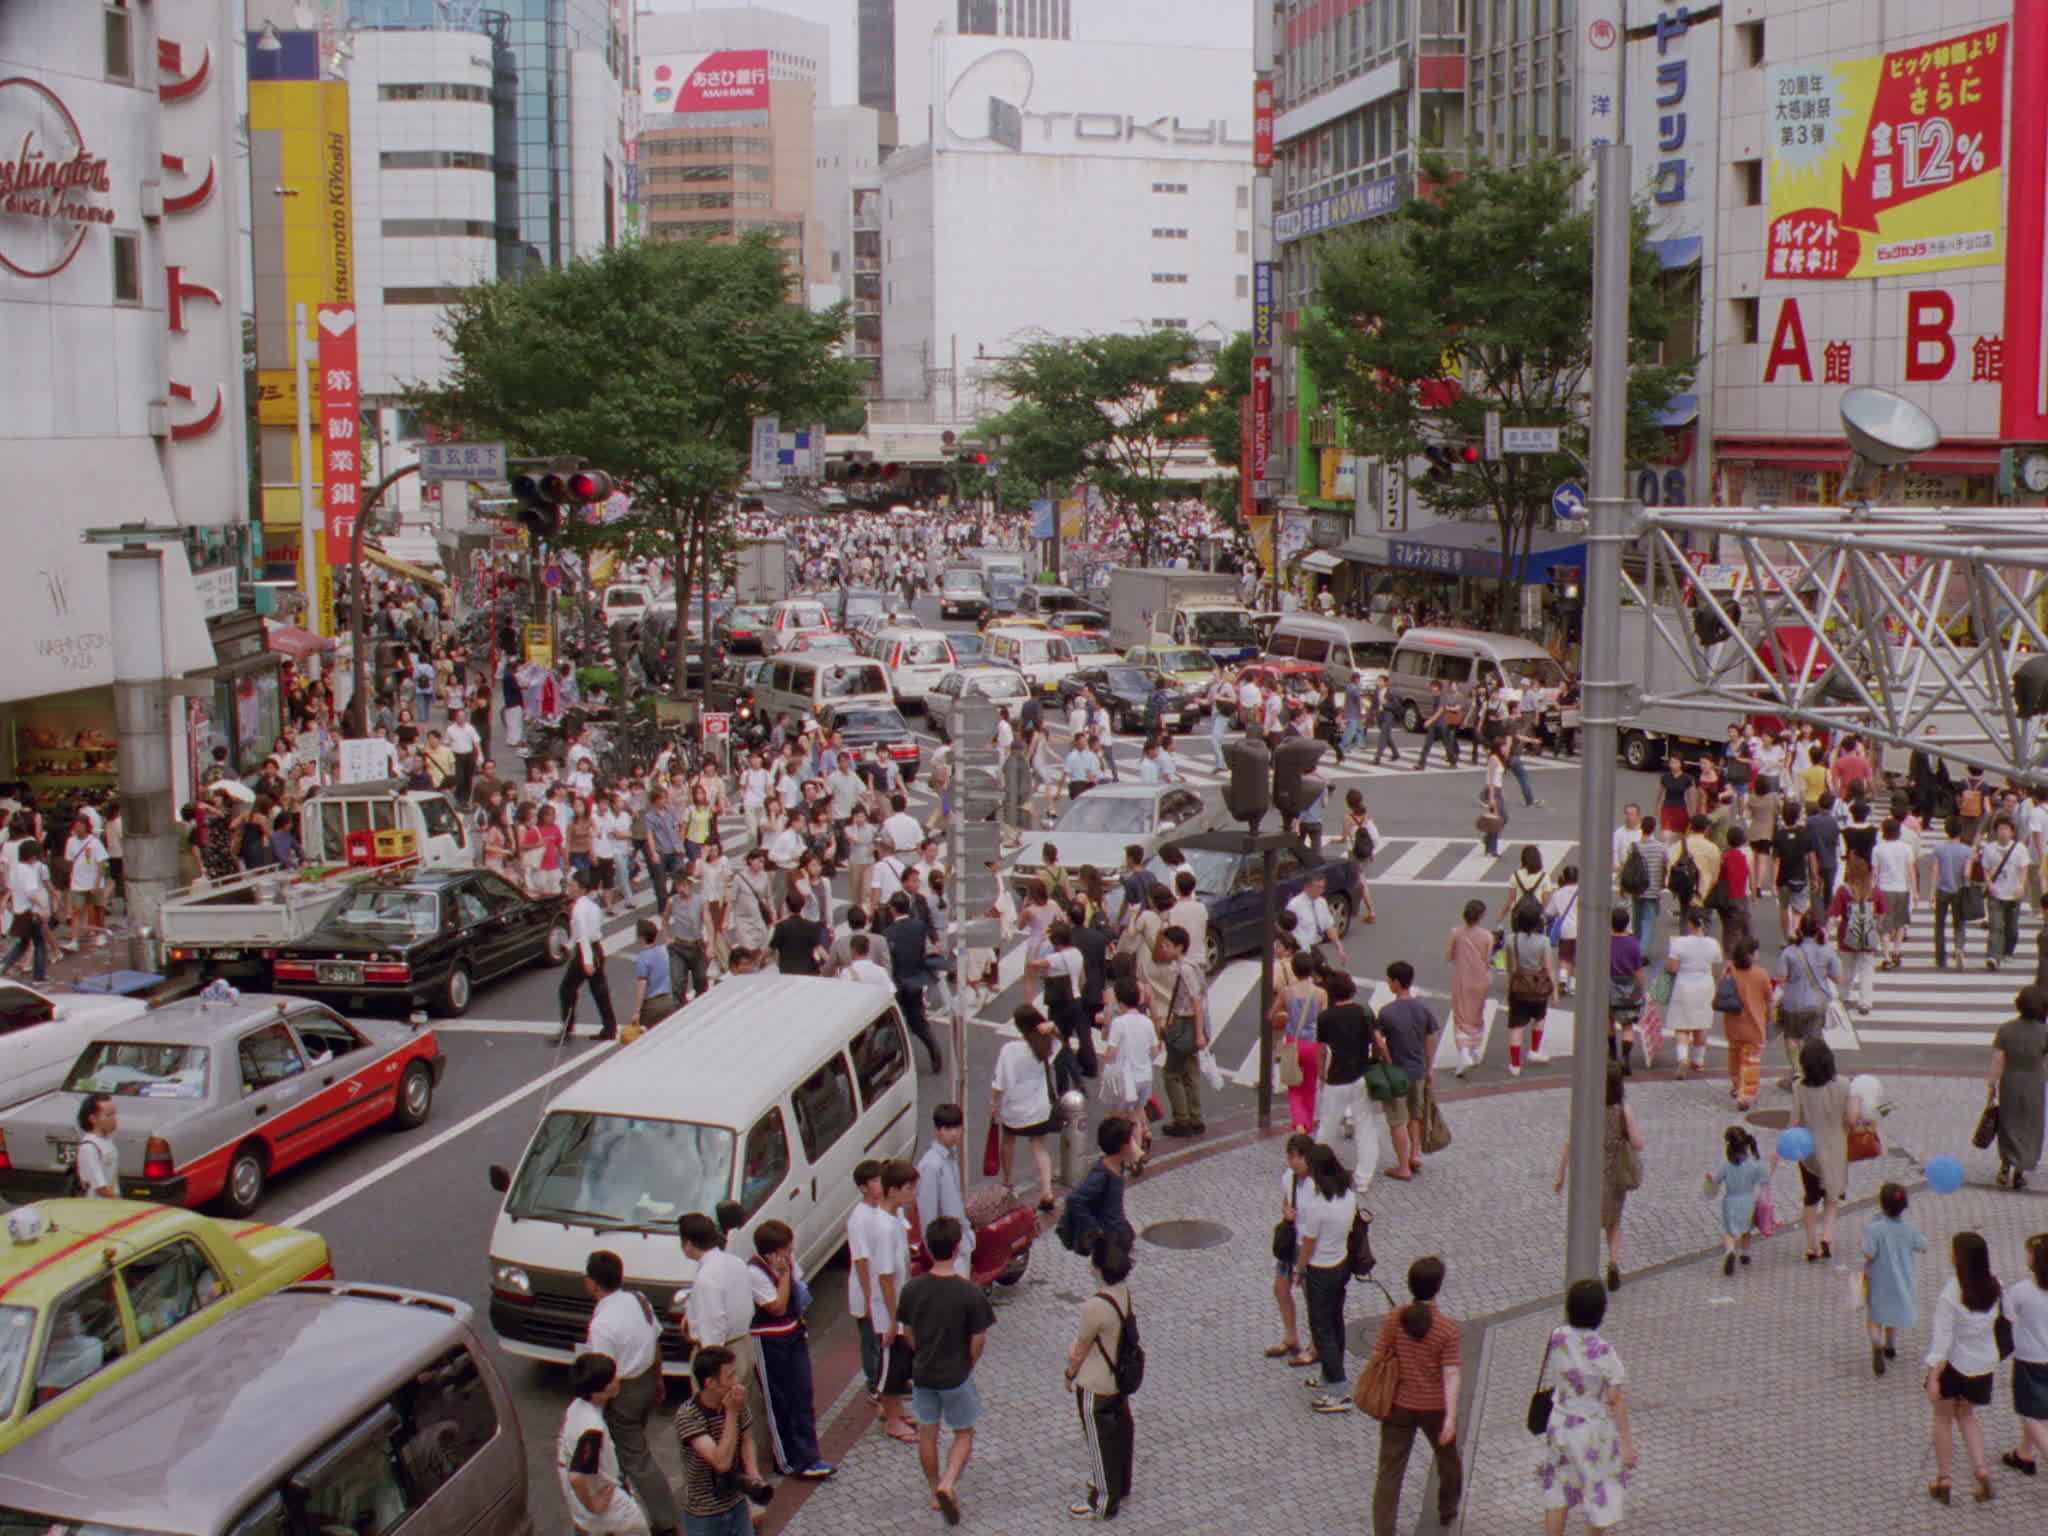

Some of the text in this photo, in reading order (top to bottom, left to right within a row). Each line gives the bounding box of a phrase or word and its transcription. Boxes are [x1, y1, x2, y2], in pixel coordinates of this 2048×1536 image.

[692, 69, 766, 88] あさひ銀行
[1778, 75, 1824, 97] 20周年
[1910, 75, 1982, 115] さらに
[1775, 97, 1831, 121] 大感謝祭
[1781, 123, 1825, 147] 第3弾
[1897, 117, 1985, 189] 12%
[1775, 218, 1839, 247] ポイント
[327, 369, 356, 538] 第一勧業銀行
